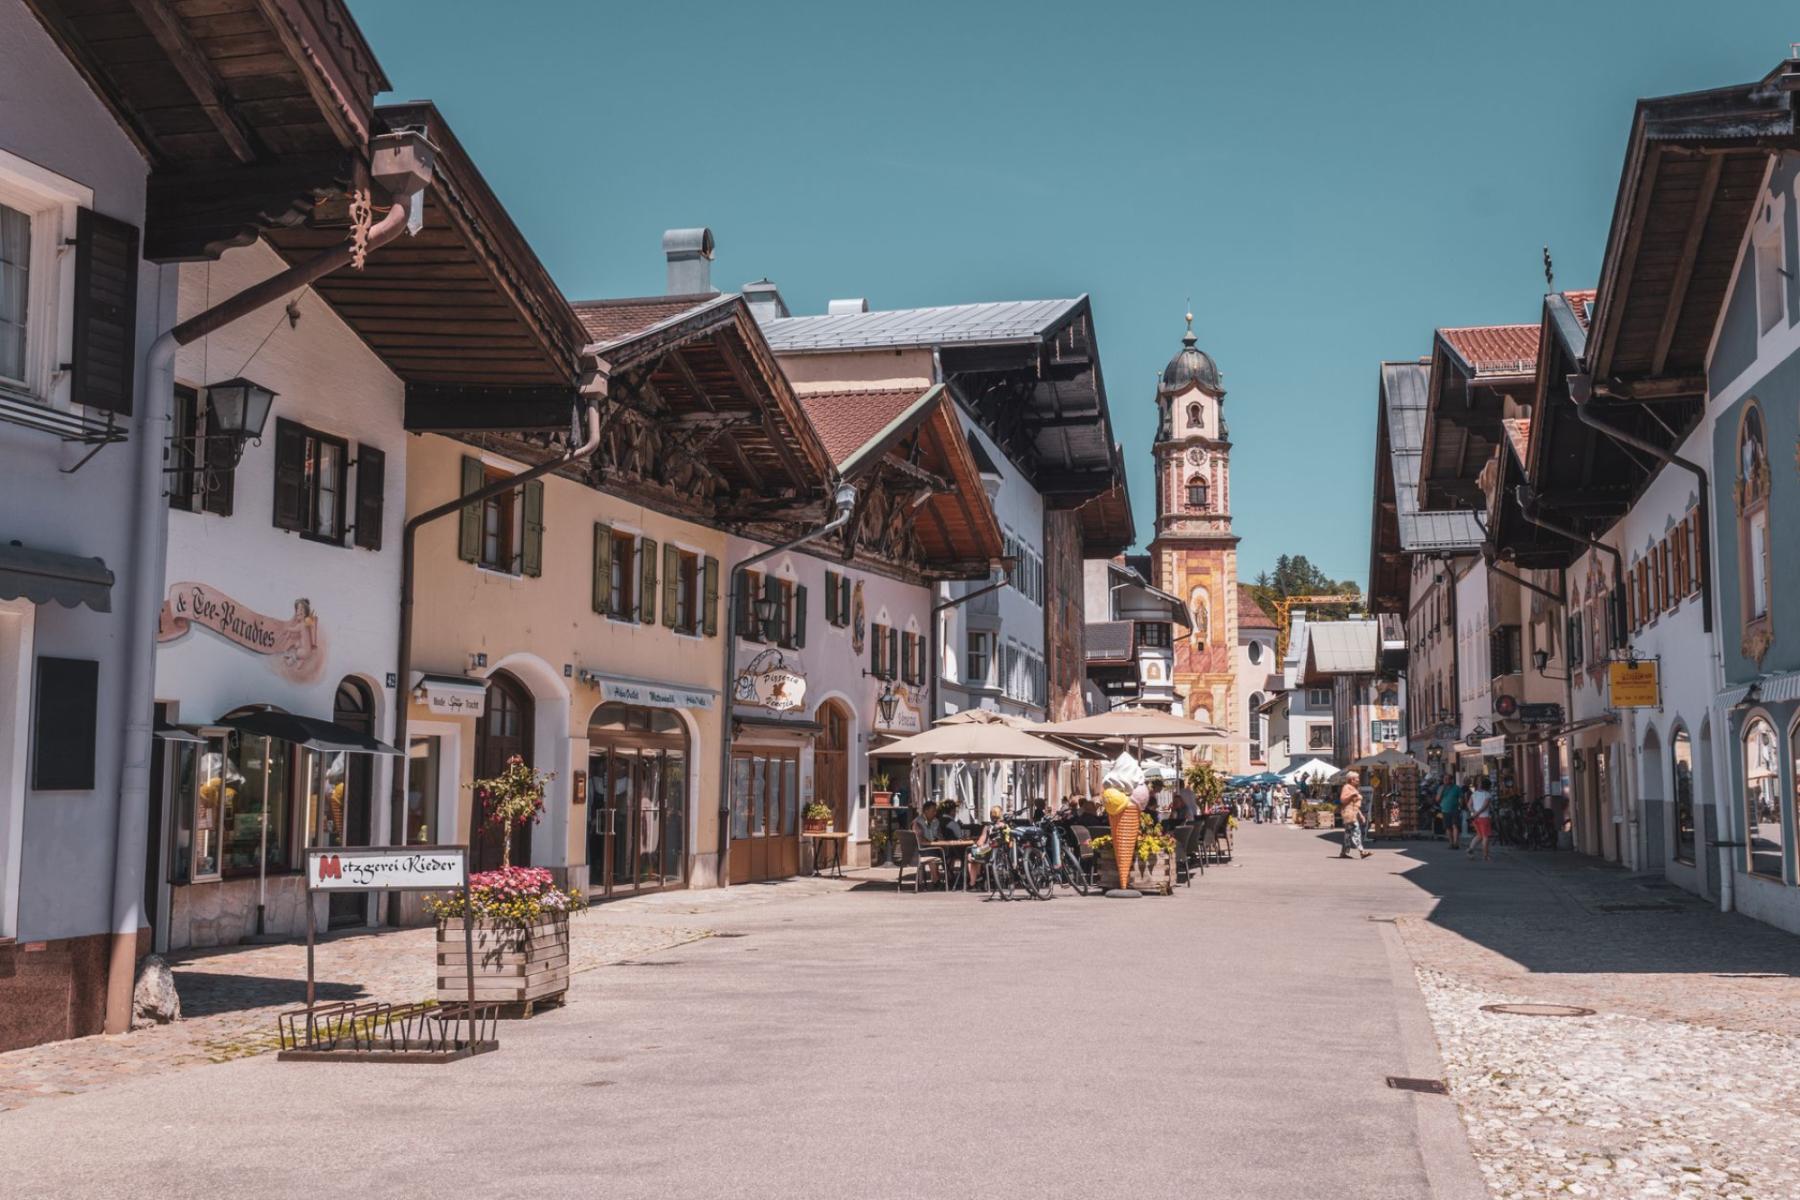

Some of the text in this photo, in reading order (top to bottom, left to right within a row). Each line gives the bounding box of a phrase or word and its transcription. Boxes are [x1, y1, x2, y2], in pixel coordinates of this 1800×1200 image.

[176, 592, 187, 613] &
[191, 586, 275, 648] Tee-Paradies
[319, 854, 456, 885] Metzgerei Rieder
